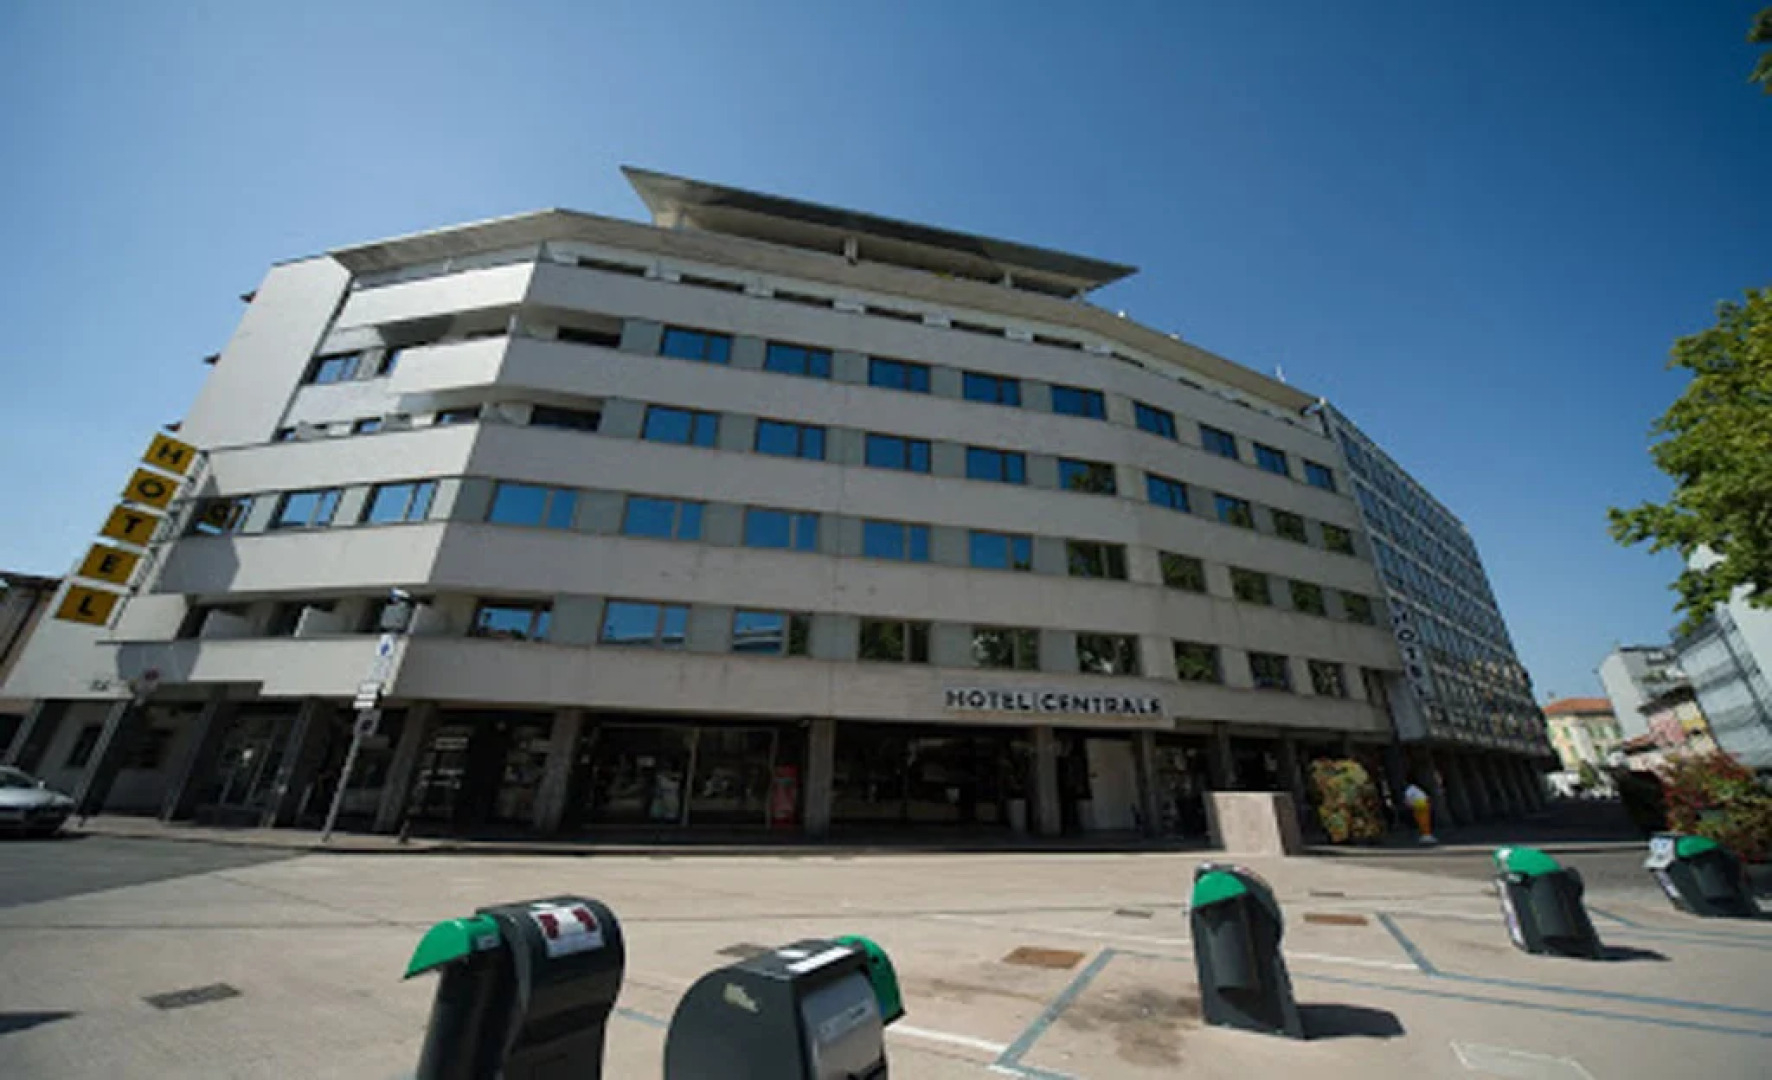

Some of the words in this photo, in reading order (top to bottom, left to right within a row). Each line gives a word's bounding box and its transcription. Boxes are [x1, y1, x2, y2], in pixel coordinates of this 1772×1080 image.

[76, 441, 186, 618] HOTEL
[945, 689, 1030, 711] HOTEL
[1039, 692, 1162, 715] CENTRALE
